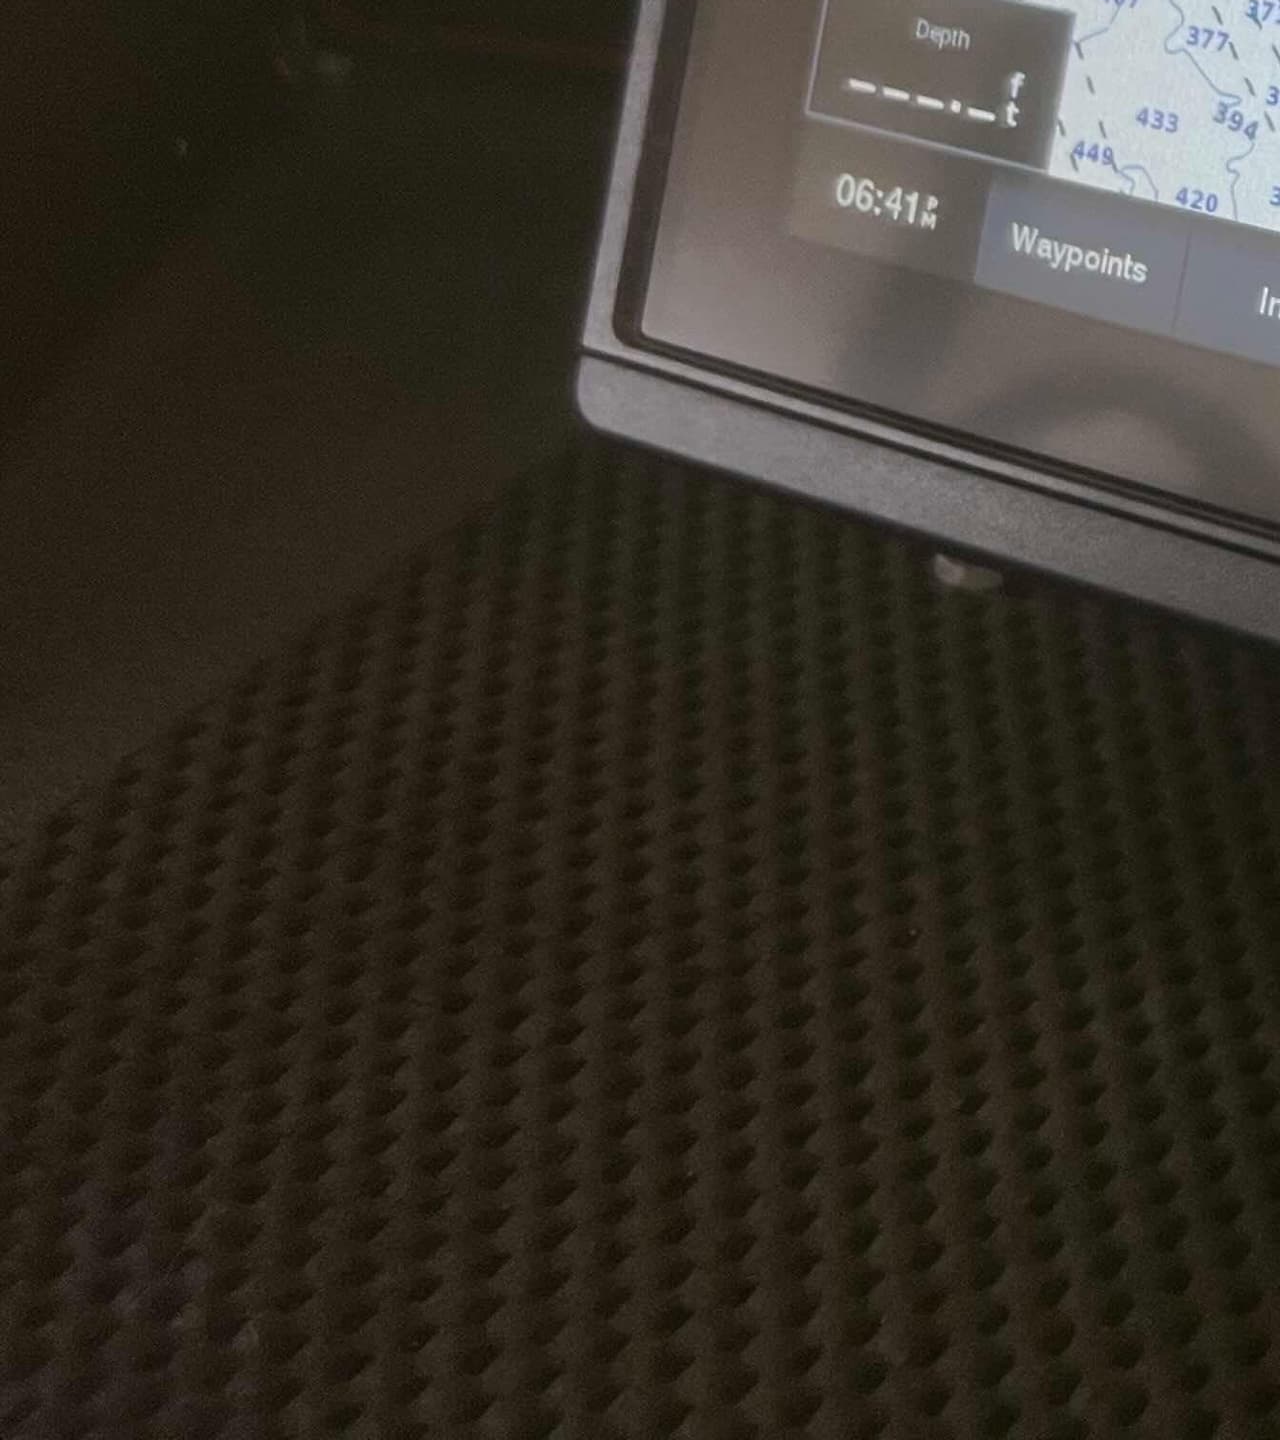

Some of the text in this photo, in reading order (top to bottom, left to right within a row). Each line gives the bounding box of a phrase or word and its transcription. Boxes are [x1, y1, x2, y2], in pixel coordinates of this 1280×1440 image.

[915, 18, 971, 50] Depth
[1187, 25, 1230, 51] 377
[1135, 107, 1179, 134] 433
[1072, 141, 1113, 166] 449
[836, 173, 919, 225] 06:41
[1175, 187, 1219, 213] 420
[1011, 222, 1149, 282] Waypoints
